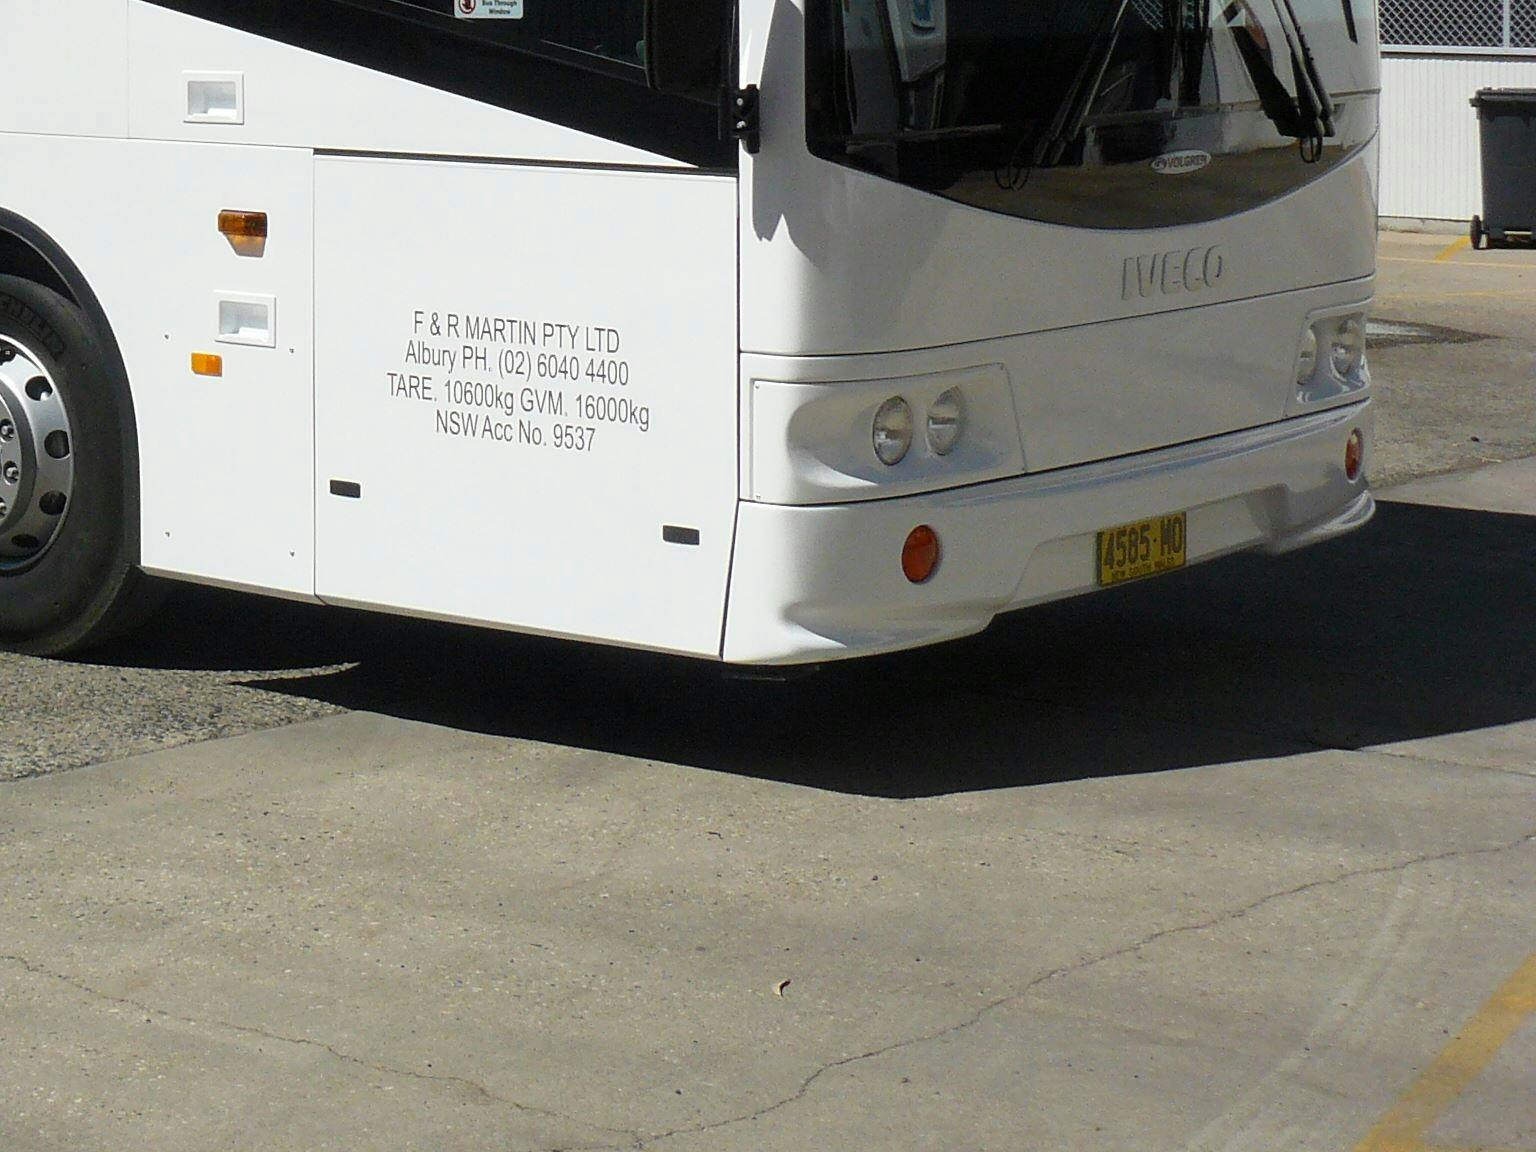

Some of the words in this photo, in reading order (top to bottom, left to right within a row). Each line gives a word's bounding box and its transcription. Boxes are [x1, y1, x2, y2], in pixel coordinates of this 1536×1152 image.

[1122, 245, 1223, 301] IVECO
[414, 310, 424, 334] F
[430, 311, 441, 336] &
[447, 313, 460, 338] R
[465, 315, 536, 346] MARTIN
[543, 322, 579, 350] PTY
[585, 326, 620, 354] LTD
[405, 339, 457, 374] Albury
[462, 345, 492, 373] PH.
[498, 349, 532, 382] (02)
[537, 353, 579, 381] 6040
[585, 359, 629, 386] 4400
[386, 372, 437, 402] TARE.
[444, 380, 514, 416] 10600kg
[519, 388, 568, 417] GVM.
[575, 394, 649, 431] 16000kg
[436, 410, 478, 438] NSW
[481, 414, 513, 443] Acc
[518, 418, 547, 447] No.
[553, 423, 596, 452] 9537
